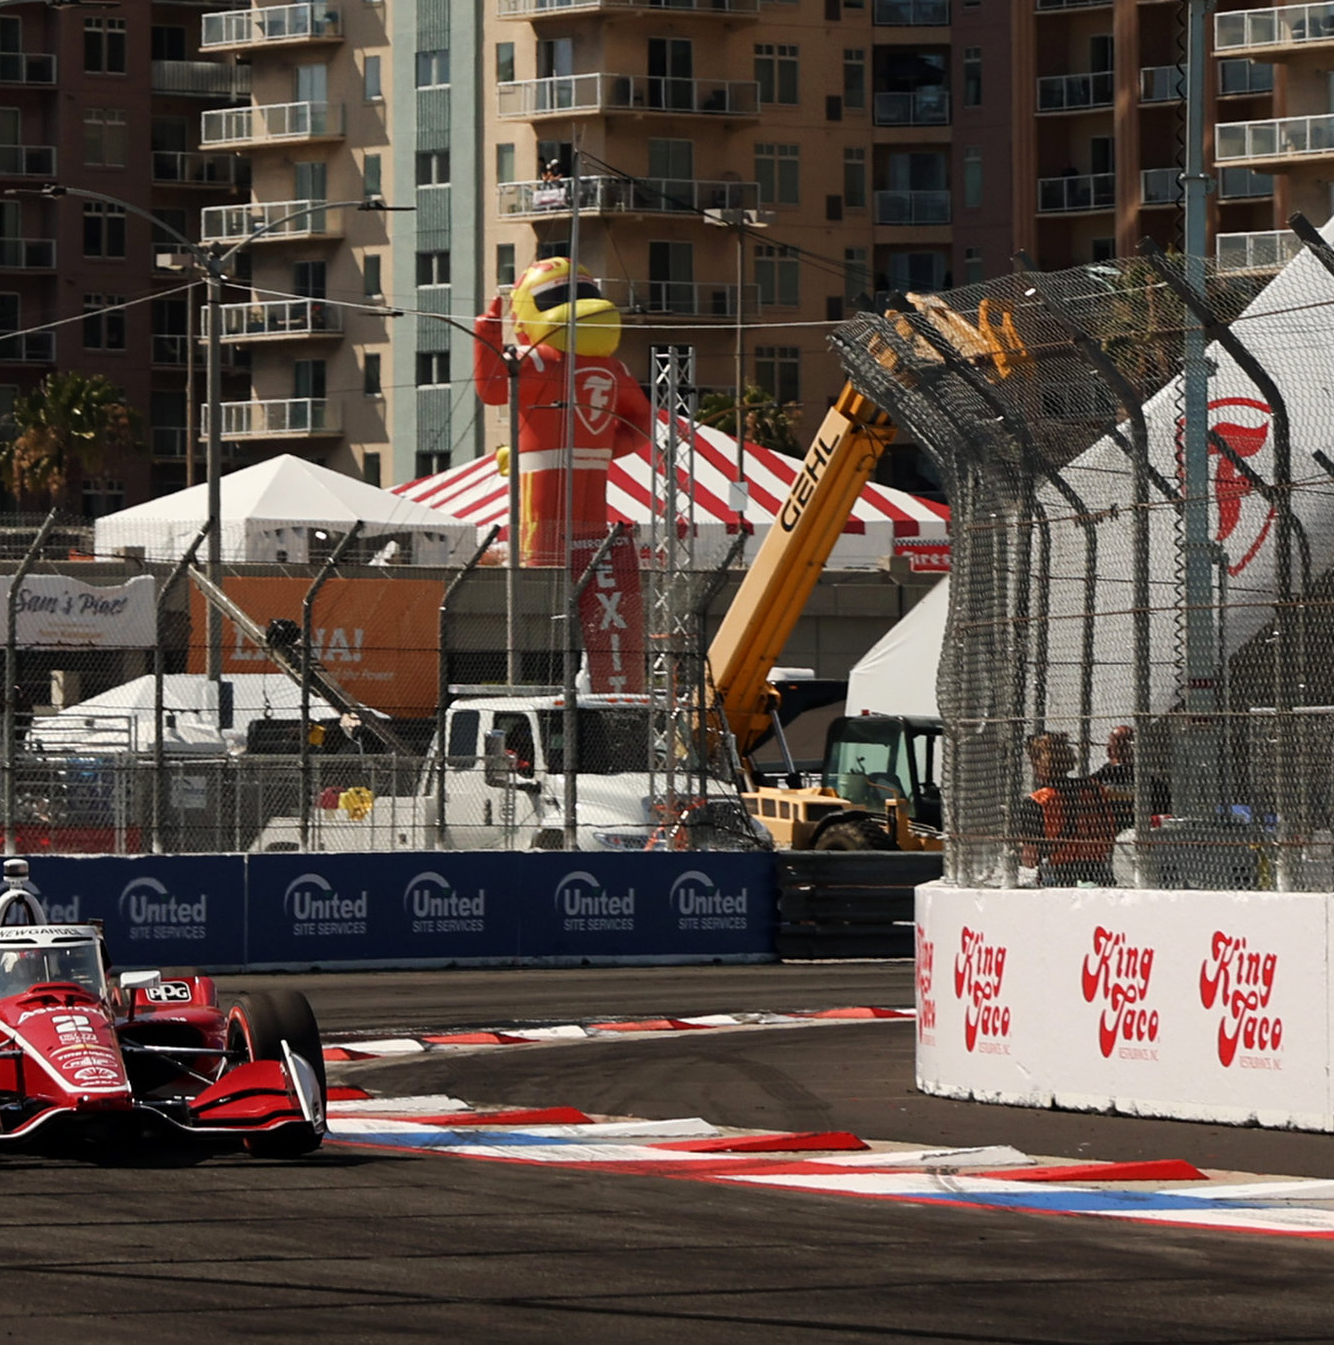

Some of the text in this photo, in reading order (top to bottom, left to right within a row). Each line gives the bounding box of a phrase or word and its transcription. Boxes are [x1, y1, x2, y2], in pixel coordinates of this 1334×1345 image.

[780, 434, 841, 533] GEHL
[130, 895, 206, 924] United
[294, 890, 367, 920] United
[413, 888, 485, 918] United
[564, 888, 635, 916] United
[678, 887, 748, 915] United
[129, 925, 206, 940] SITE SERVICES
[293, 922, 367, 936] SITE SERVICES
[412, 919, 484, 933] SITE SERVICES
[563, 918, 634, 931] SITE SERVICES
[678, 917, 747, 930] SITE SERVICES
[954, 926, 1007, 999] King
[1082, 926, 1155, 1003] King
[1200, 930, 1278, 1010] King
[149, 983, 188, 1002] PPG
[51, 1015, 94, 1033] 2
[965, 980, 1011, 1052] Taco
[1099, 983, 1159, 1058] Taco
[1218, 990, 1283, 1068] Taco
